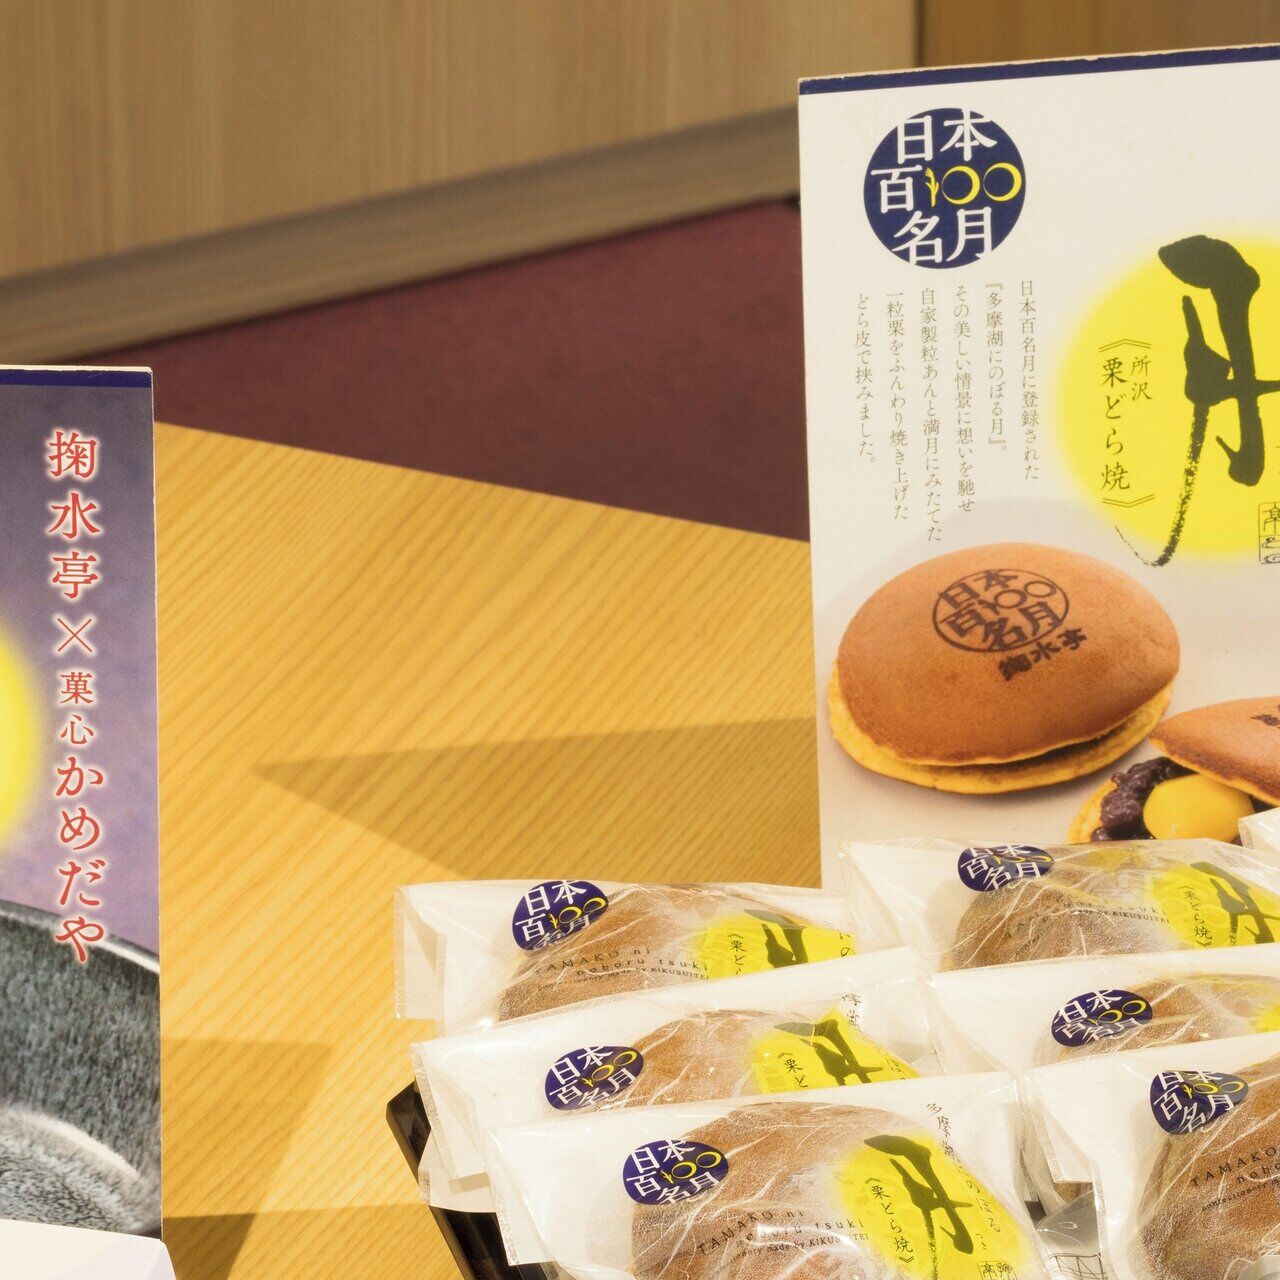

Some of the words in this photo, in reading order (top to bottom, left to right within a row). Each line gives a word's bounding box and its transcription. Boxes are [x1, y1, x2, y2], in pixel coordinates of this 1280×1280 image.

[855, 293, 875, 463] どら皮で挟みました。
[886, 292, 909, 520] 一粒栗をふんわり焼き上げた
[920, 288, 941, 542] 自家製粒あんと満月にみたてた
[953, 285, 975, 512] その美しい情景に想いを馳せ
[1019, 280, 1040, 480] 日本百名月に登録された
[550, 1045, 613, 1085] 日本
[626, 1138, 695, 1174] 日本
[1190, 1145, 1277, 1187] TAMAKO
